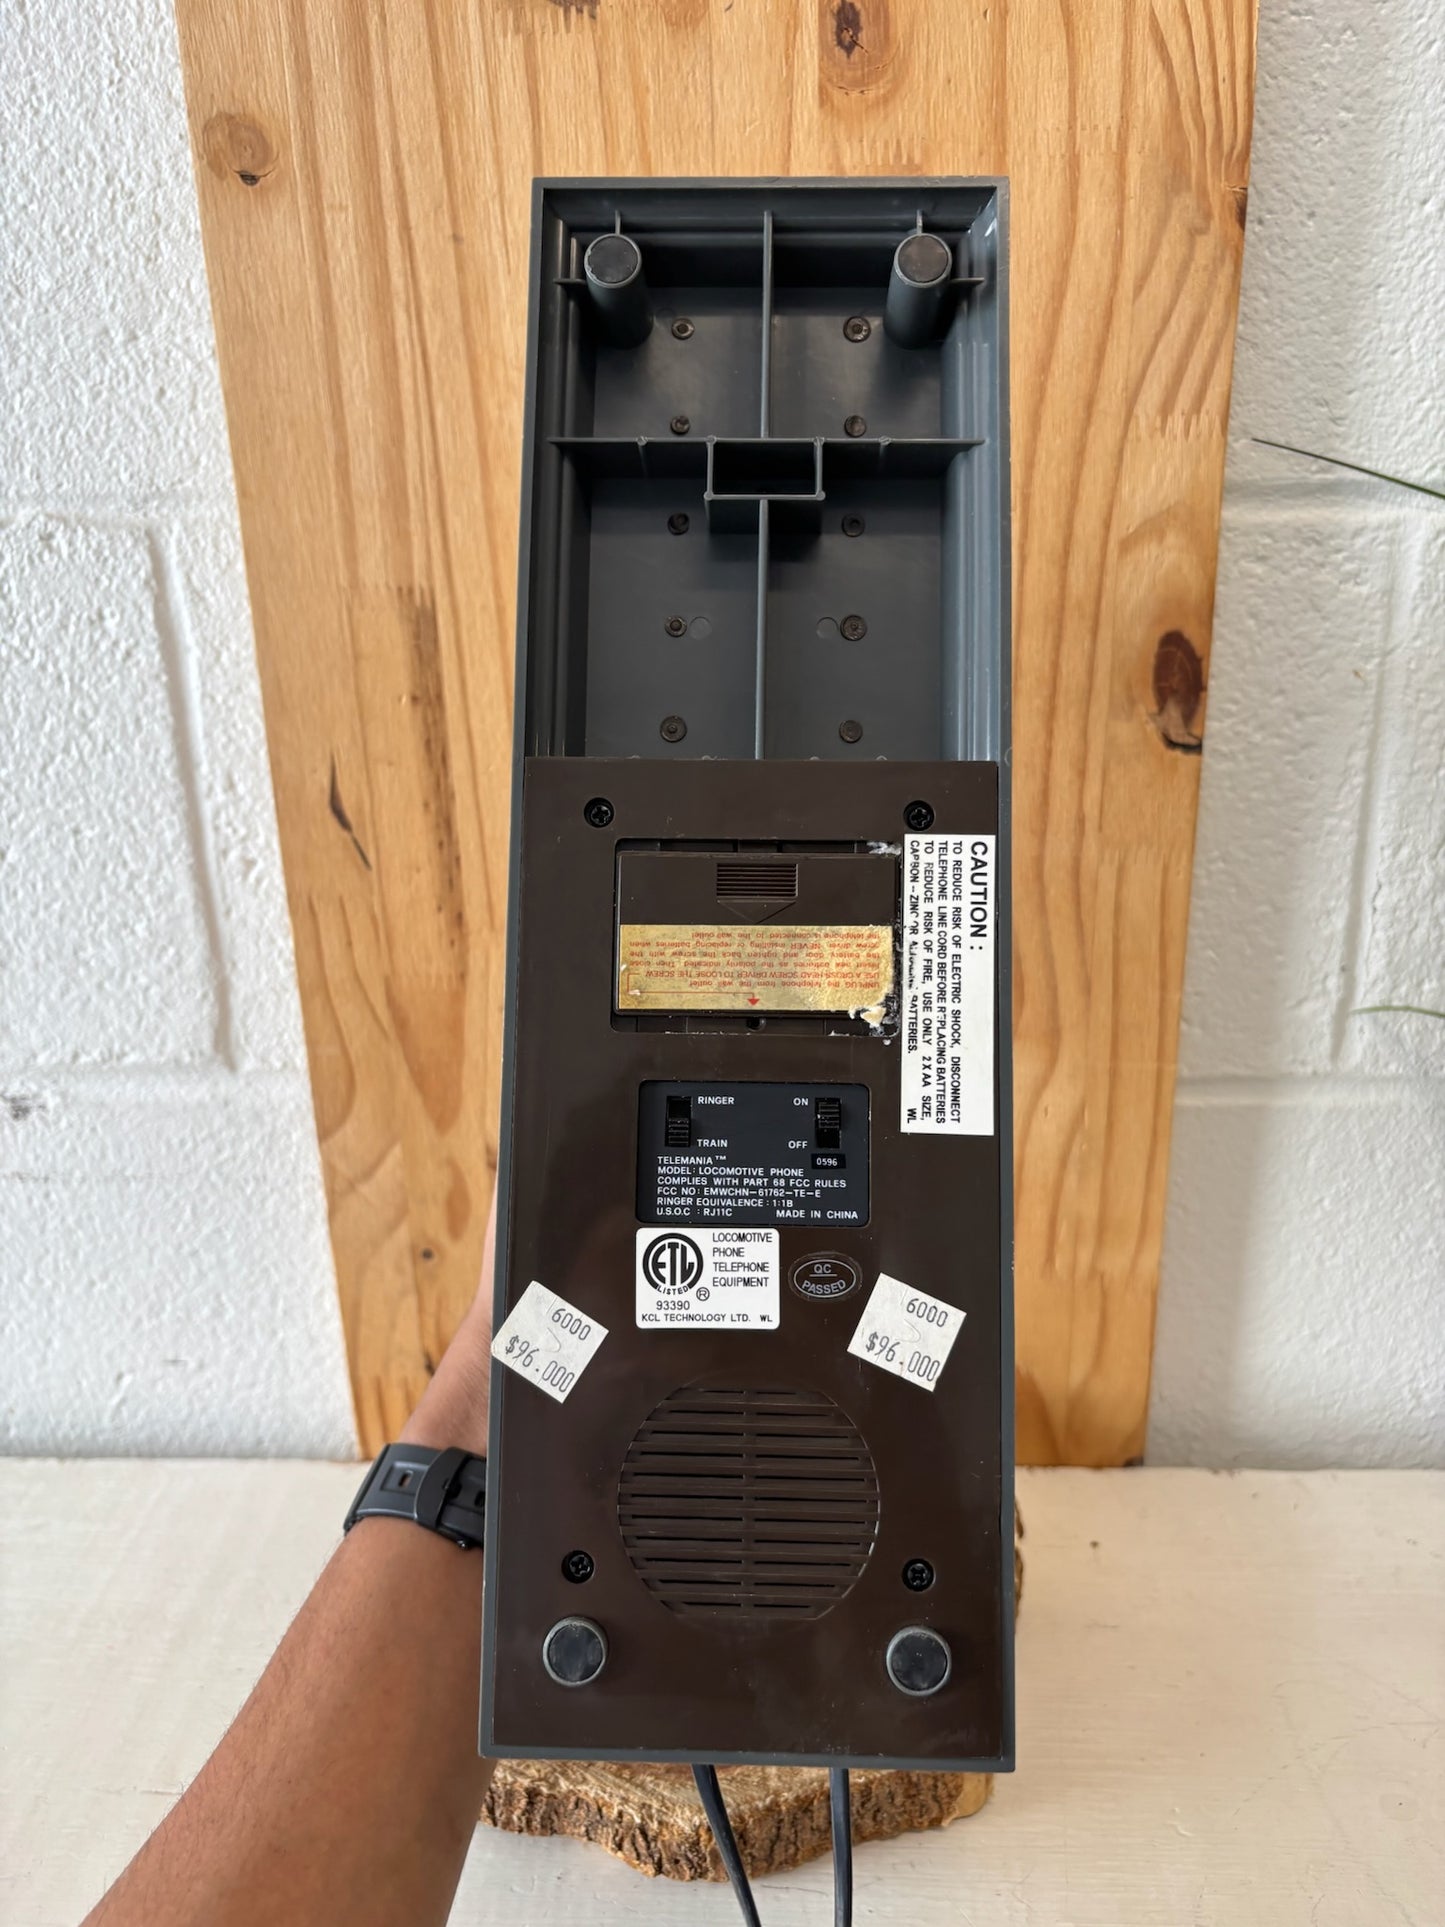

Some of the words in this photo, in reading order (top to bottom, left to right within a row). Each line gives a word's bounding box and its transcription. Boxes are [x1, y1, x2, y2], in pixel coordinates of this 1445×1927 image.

[924, 840, 934, 854] TO
[952, 840, 963, 855] TO
[938, 840, 948, 901] TELEPHONE
[924, 862, 934, 904] REDUCE
[952, 859, 962, 902] REDUCE
[923, 910, 934, 935] RISK
[937, 906, 948, 928] LINE
[952, 906, 962, 930] RISK
[824, 932, 864, 940] telephone
[951, 934, 962, 949] OF
[750, 941, 785, 949] installing
[923, 939, 933, 954] OF
[937, 930, 948, 960] CORD
[748, 951, 777, 959] tighten
[656, 960, 675, 968] Then
[726, 960, 756, 968] polarity
[645, 970, 675, 978] SCREW
[678, 970, 692, 978] THE
[695, 970, 722, 978] LOOSE
[724, 970, 734, 978] TO
[921, 958, 933, 984] FIRE,
[781, 980, 821, 988] telephone
[937, 962, 947, 1004] BEFORE
[951, 953, 962, 1004] ELECTRIC
[922, 992, 933, 1013] USE
[922, 1018, 932, 1046] ONLY
[950, 1009, 961, 1048] SHOCK,
[922, 1072, 932, 1088] AA
[936, 1067, 946, 1124] BATTERIES
[950, 1056, 961, 1124] DISCONNECT
[697, 1096, 735, 1105] RINGER
[793, 1097, 809, 1106] ON
[920, 1095, 932, 1121] SIZE,
[906, 1108, 917, 1124] WL
[697, 1139, 728, 1148] TRAIN
[788, 1140, 808, 1149] OFF
[816, 1157, 838, 1167] 0596
[699, 1167, 764, 1176] LOCOMOTIVE
[770, 1168, 804, 1177] PHONE
[657, 1176, 708, 1185] COMPLIES
[713, 1177, 739, 1186] WITH
[743, 1178, 769, 1187] PART
[773, 1178, 785, 1187] 68
[789, 1178, 810, 1188] FCC
[814, 1179, 847, 1188] RULES
[657, 1187, 678, 1196] FCC
[656, 1197, 693, 1206] RINGER
[696, 1197, 764, 1208] EQUIVALENCE
[703, 1208, 733, 1217] RJ11C
[776, 1209, 806, 1218] MADE
[811, 1210, 821, 1219] IN
[826, 1210, 859, 1220] CHINA
[712, 1232, 773, 1243] LOCOMOTIVE
[712, 1247, 745, 1257] PHONE
[651, 1241, 695, 1286] ETL
[713, 1262, 770, 1272] TELEPHONE
[813, 1263, 832, 1274] QC
[712, 1277, 770, 1287] EQUIPMENT
[801, 1279, 847, 1295] PASSED
[657, 1284, 690, 1296] LISTED
[656, 1300, 690, 1310] 93390
[641, 1313, 660, 1322] KCL
[664, 1313, 727, 1322] TECHNOLOGY
[731, 1313, 751, 1322] LTD.
[759, 1314, 773, 1322] WL
[906, 1298, 948, 1328] 6000
[551, 1308, 592, 1341] 6000
